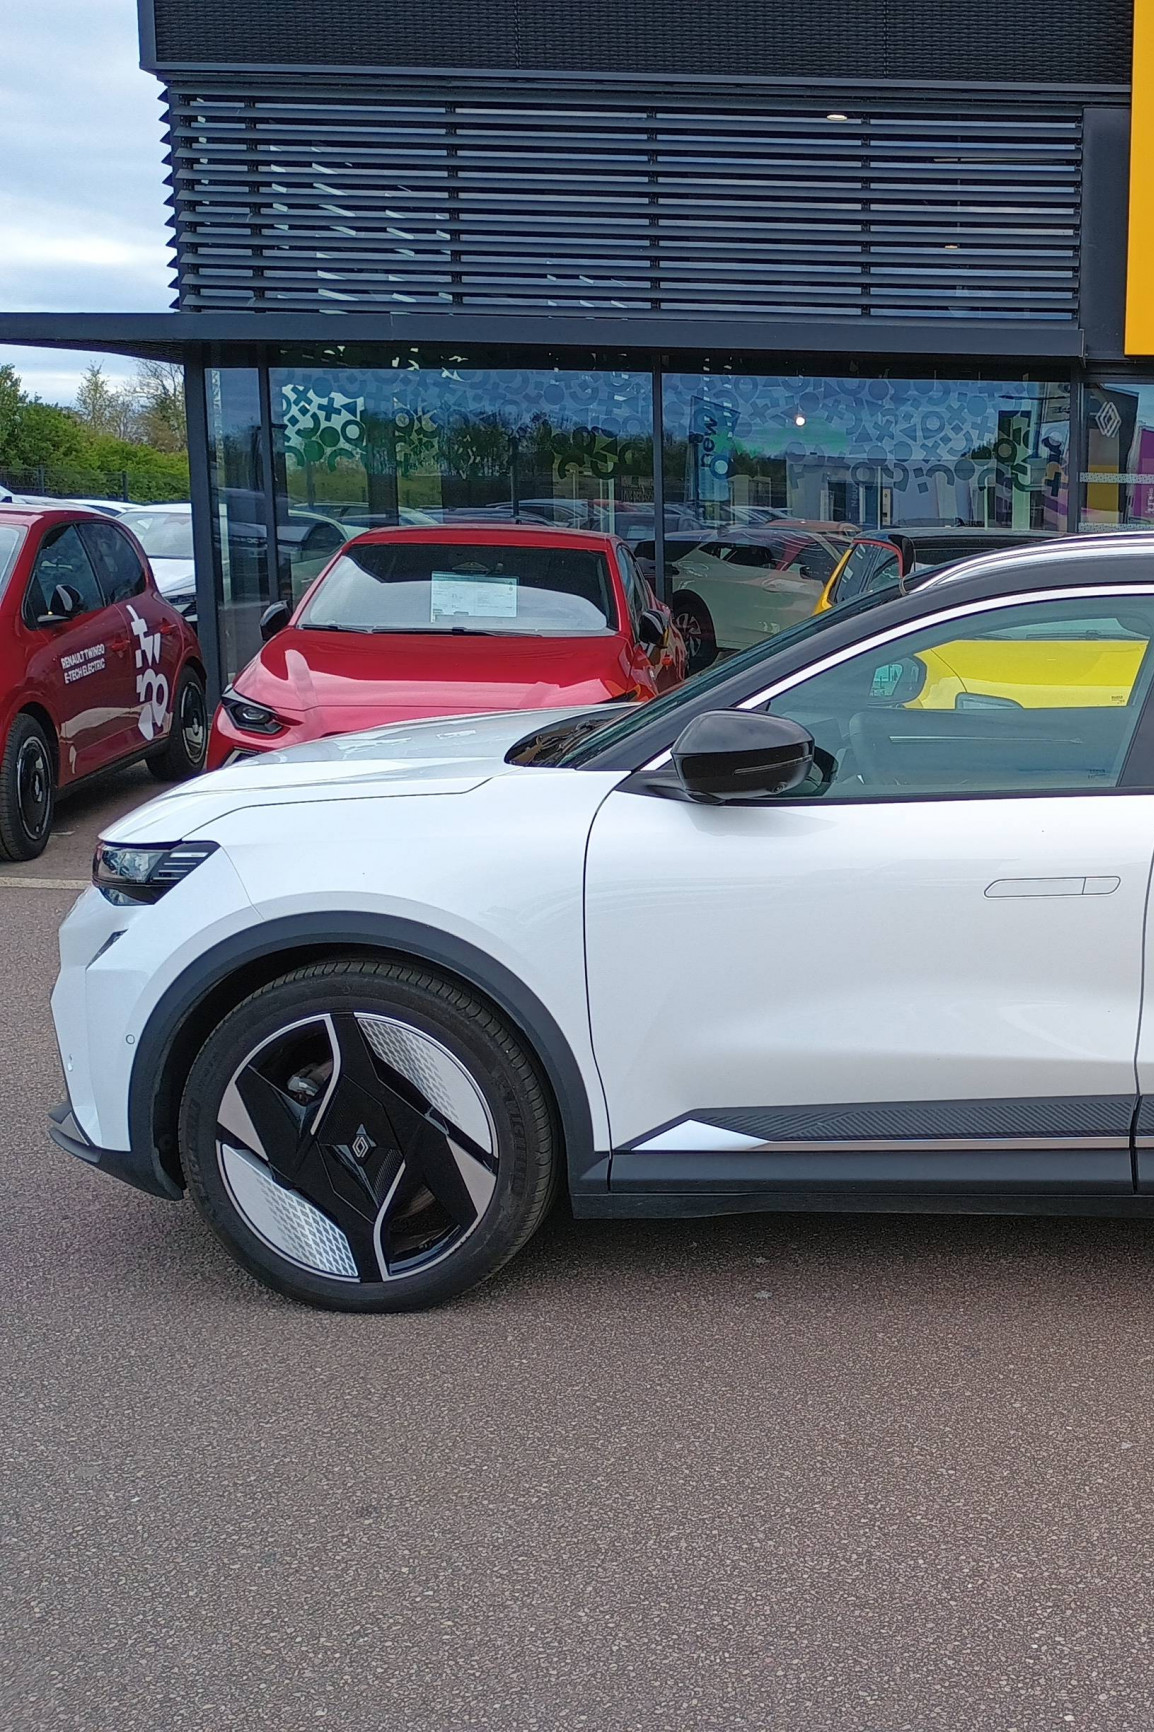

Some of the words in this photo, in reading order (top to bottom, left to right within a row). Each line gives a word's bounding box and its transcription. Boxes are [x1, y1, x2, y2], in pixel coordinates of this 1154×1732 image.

[61, 650, 84, 669] RENAULT
[84, 643, 105, 660] TWINGO
[64, 667, 83, 684] E-TECH
[82, 658, 106, 676] ELECTRIC
